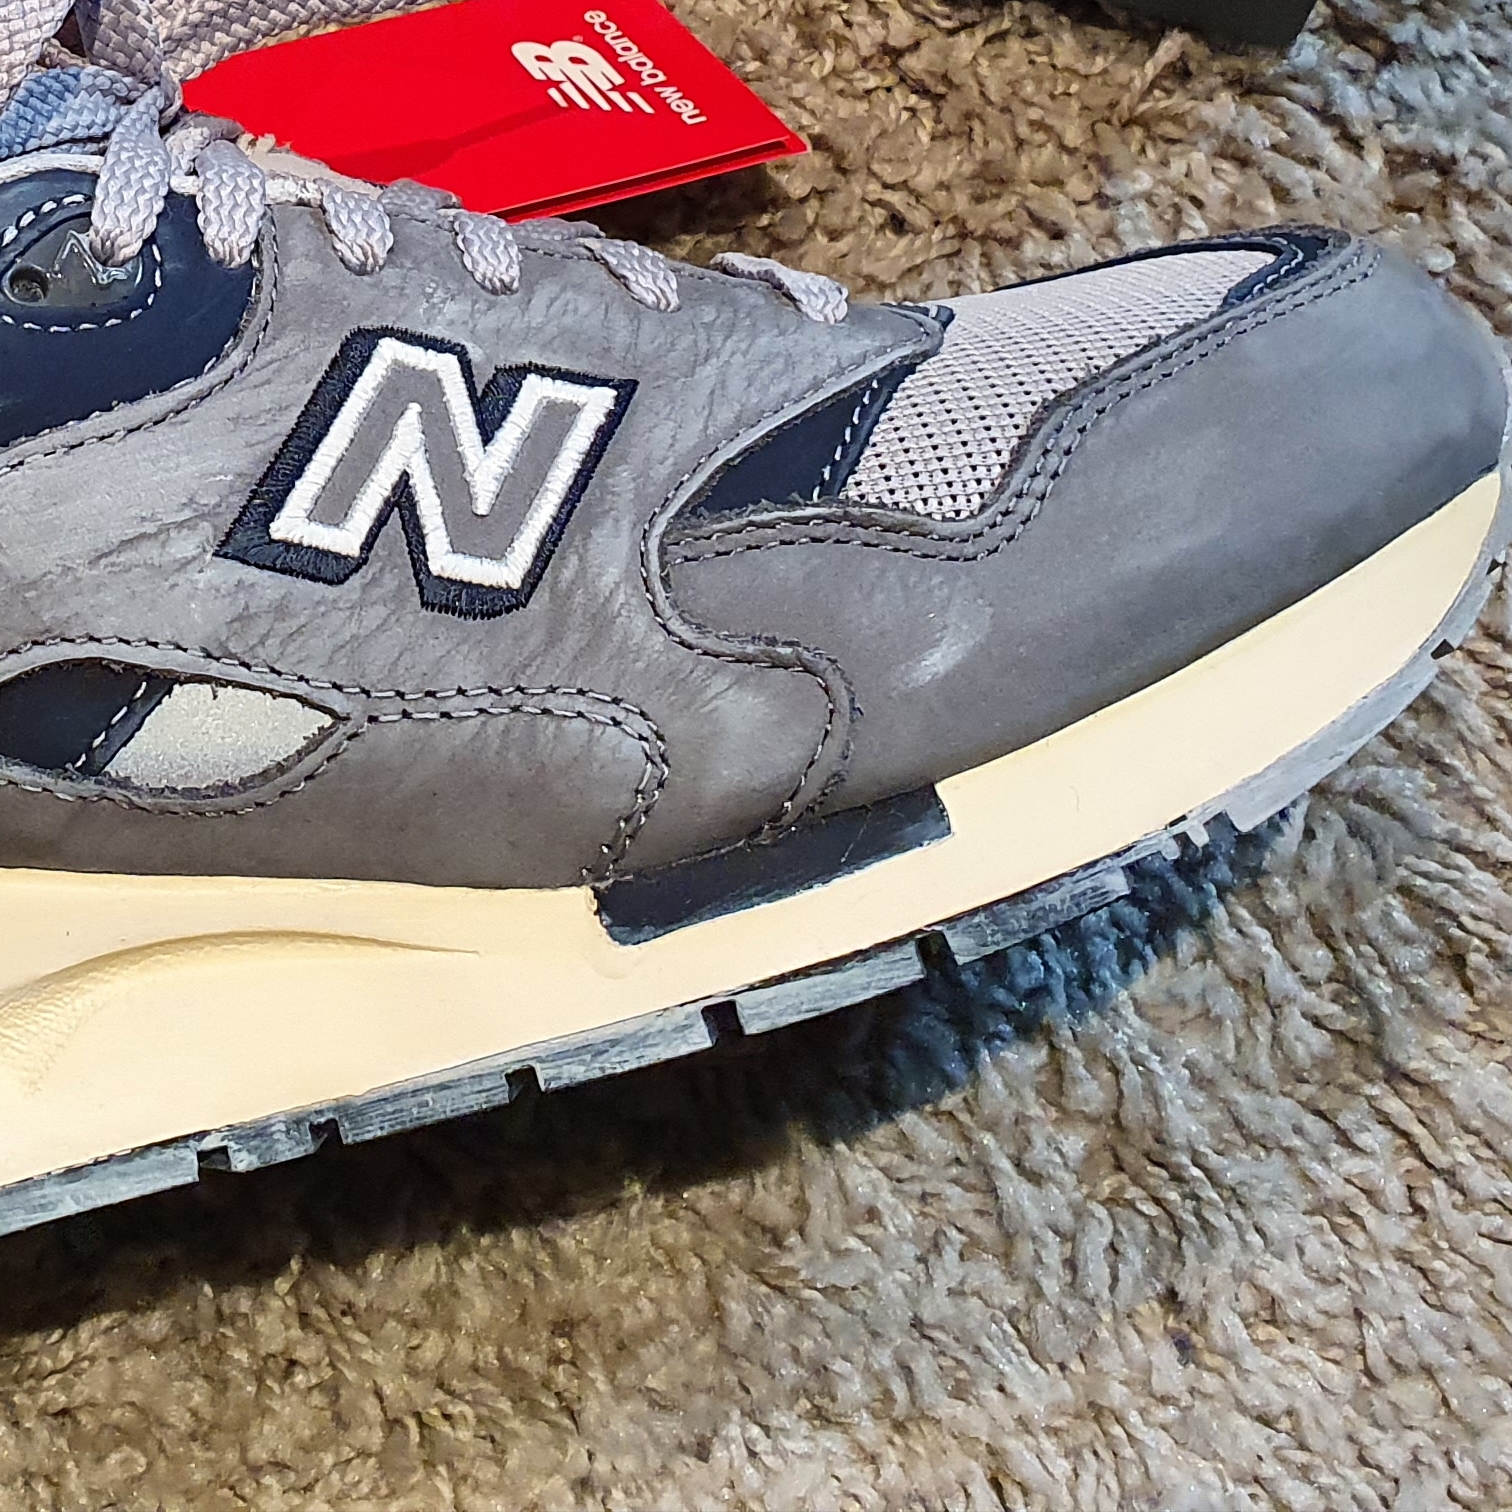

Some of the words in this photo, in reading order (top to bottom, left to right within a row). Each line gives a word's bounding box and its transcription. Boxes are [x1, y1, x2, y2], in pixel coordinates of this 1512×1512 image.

[583, 9, 668, 87] balance
[653, 85, 708, 125] new
[269, 336, 618, 590] N
